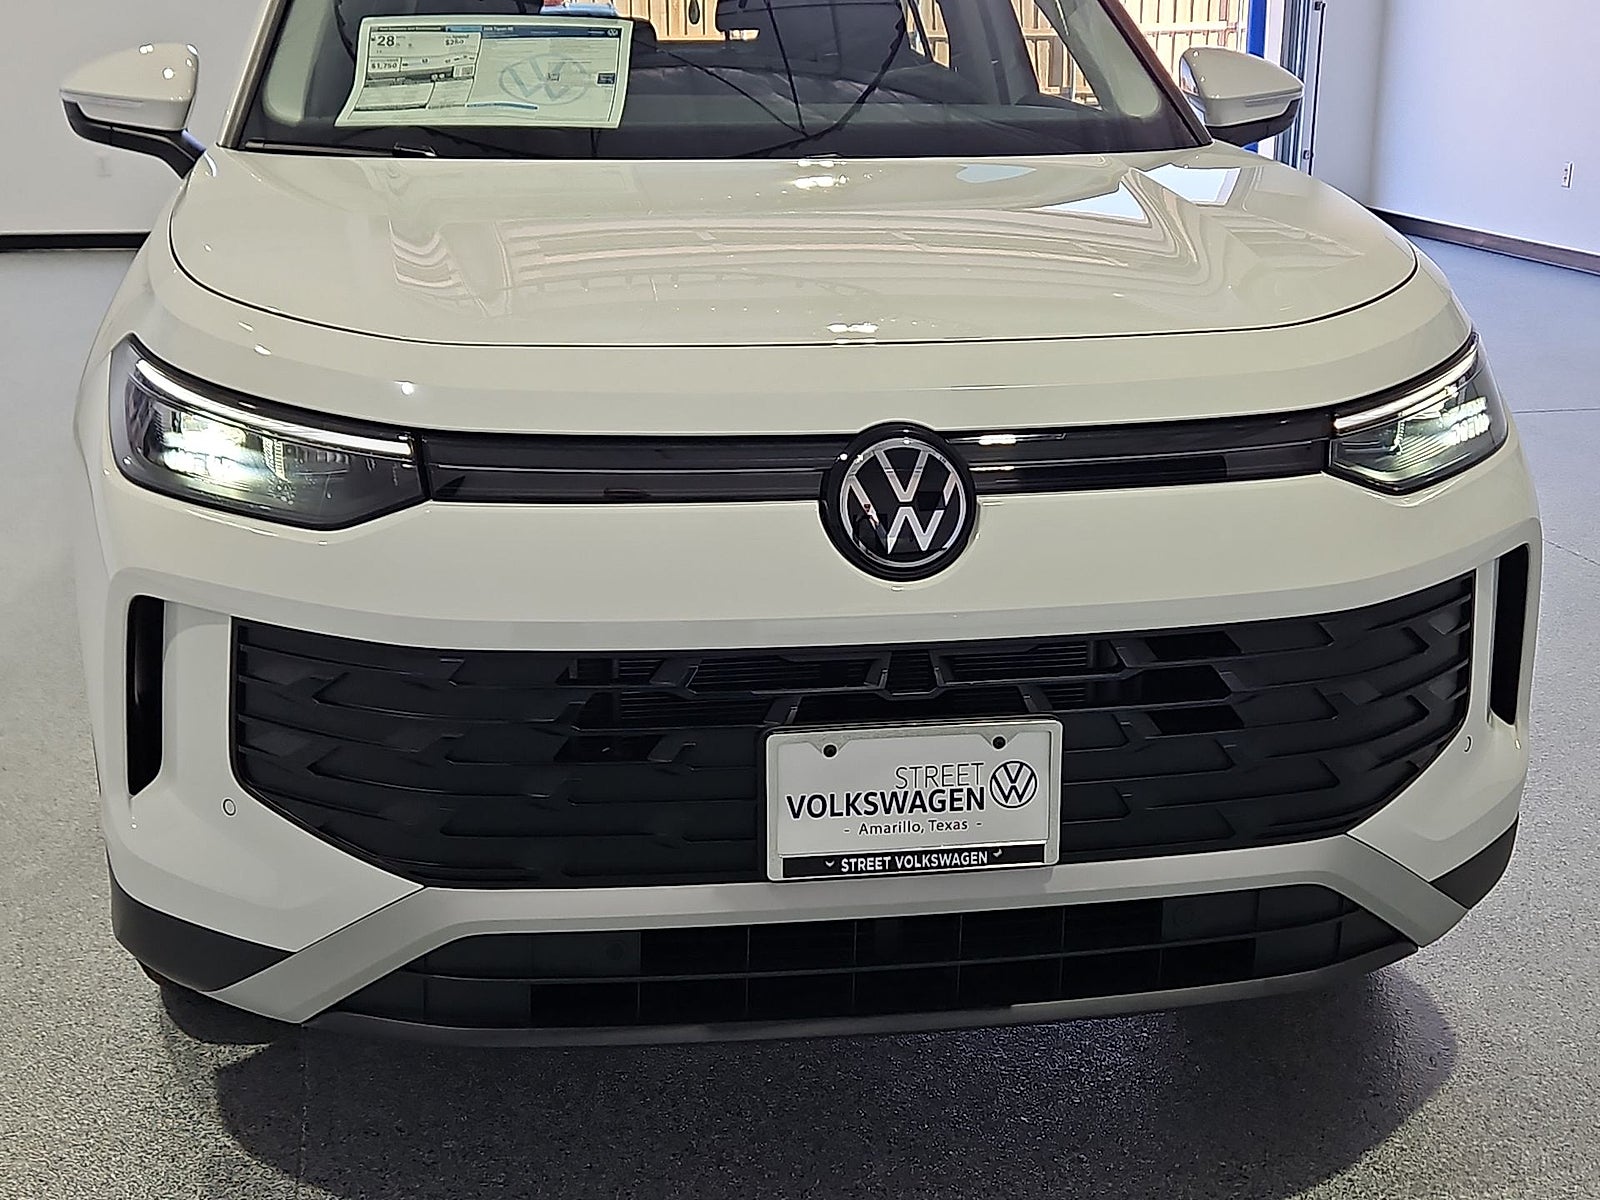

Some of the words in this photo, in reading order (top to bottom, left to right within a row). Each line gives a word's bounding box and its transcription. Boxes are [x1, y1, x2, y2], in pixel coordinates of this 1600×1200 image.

[377, 35, 395, 47] 28
[839, 437, 967, 568] VW
[895, 761, 985, 789] STREET
[989, 760, 1038, 809] VW
[786, 786, 985, 820] VOLKSWAGEN
[858, 820, 925, 836] Amarillo,
[928, 819, 968, 833] Texas
[841, 856, 891, 873] STREET
[896, 850, 988, 868] VOLKSWAGEN
